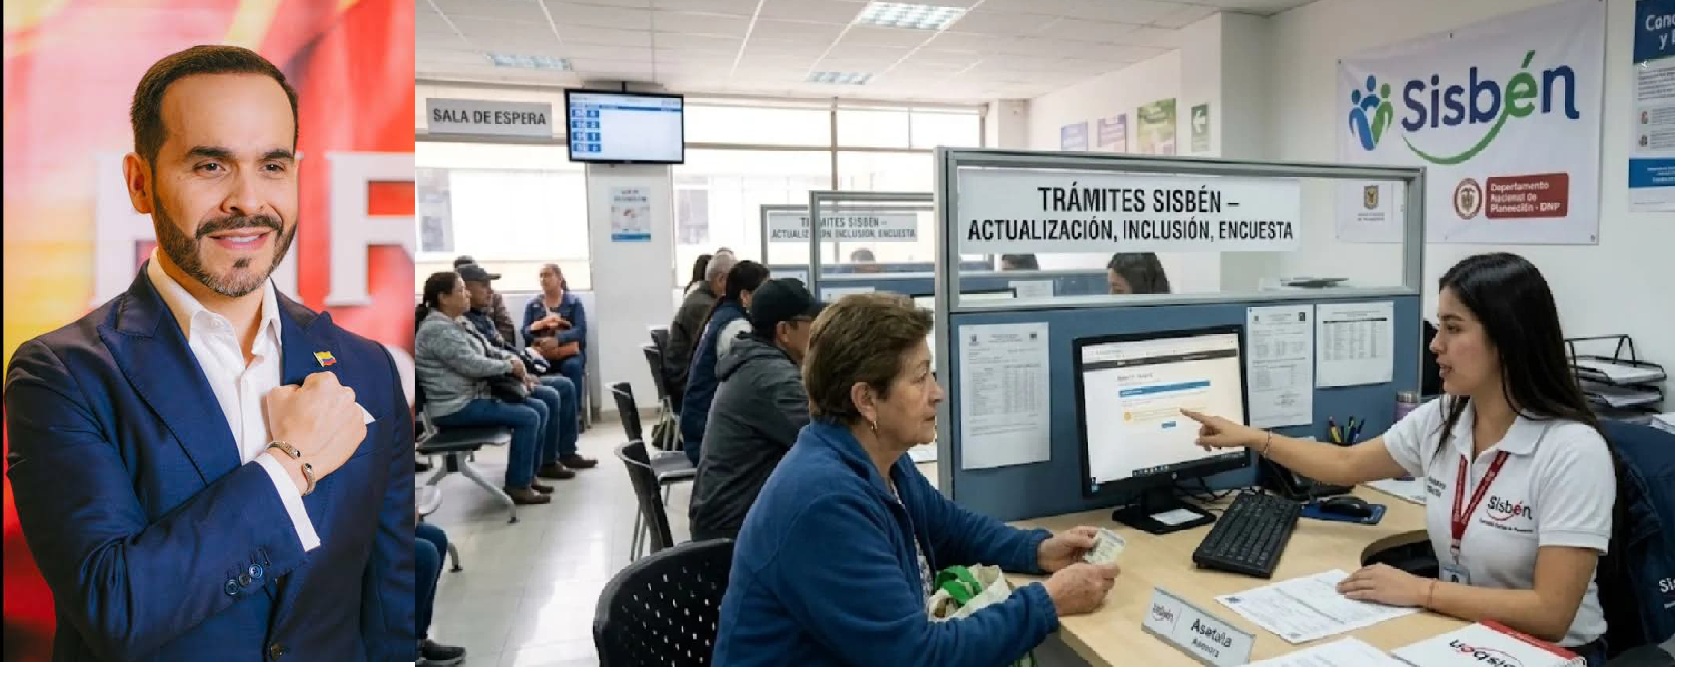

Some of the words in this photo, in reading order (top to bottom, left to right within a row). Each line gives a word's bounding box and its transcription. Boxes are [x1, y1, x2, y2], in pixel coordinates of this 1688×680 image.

[1645, 14, 1675, 31] Can
[1401, 50, 1580, 132] Sisbén
[432, 108, 469, 123] SALA
[473, 110, 492, 124] DE
[494, 110, 546, 125] ESPERA
[1037, 181, 1145, 212] TRÁMITES
[1153, 185, 1221, 213] SISBÉN
[968, 216, 1118, 243] ACTUALIZACIÓN,
[1123, 216, 1214, 242] INCLUSIÓN,
[1219, 220, 1293, 240] ENCUESTA
[1487, 495, 1533, 520] Sisbén
[1658, 577, 1675, 594] Si
